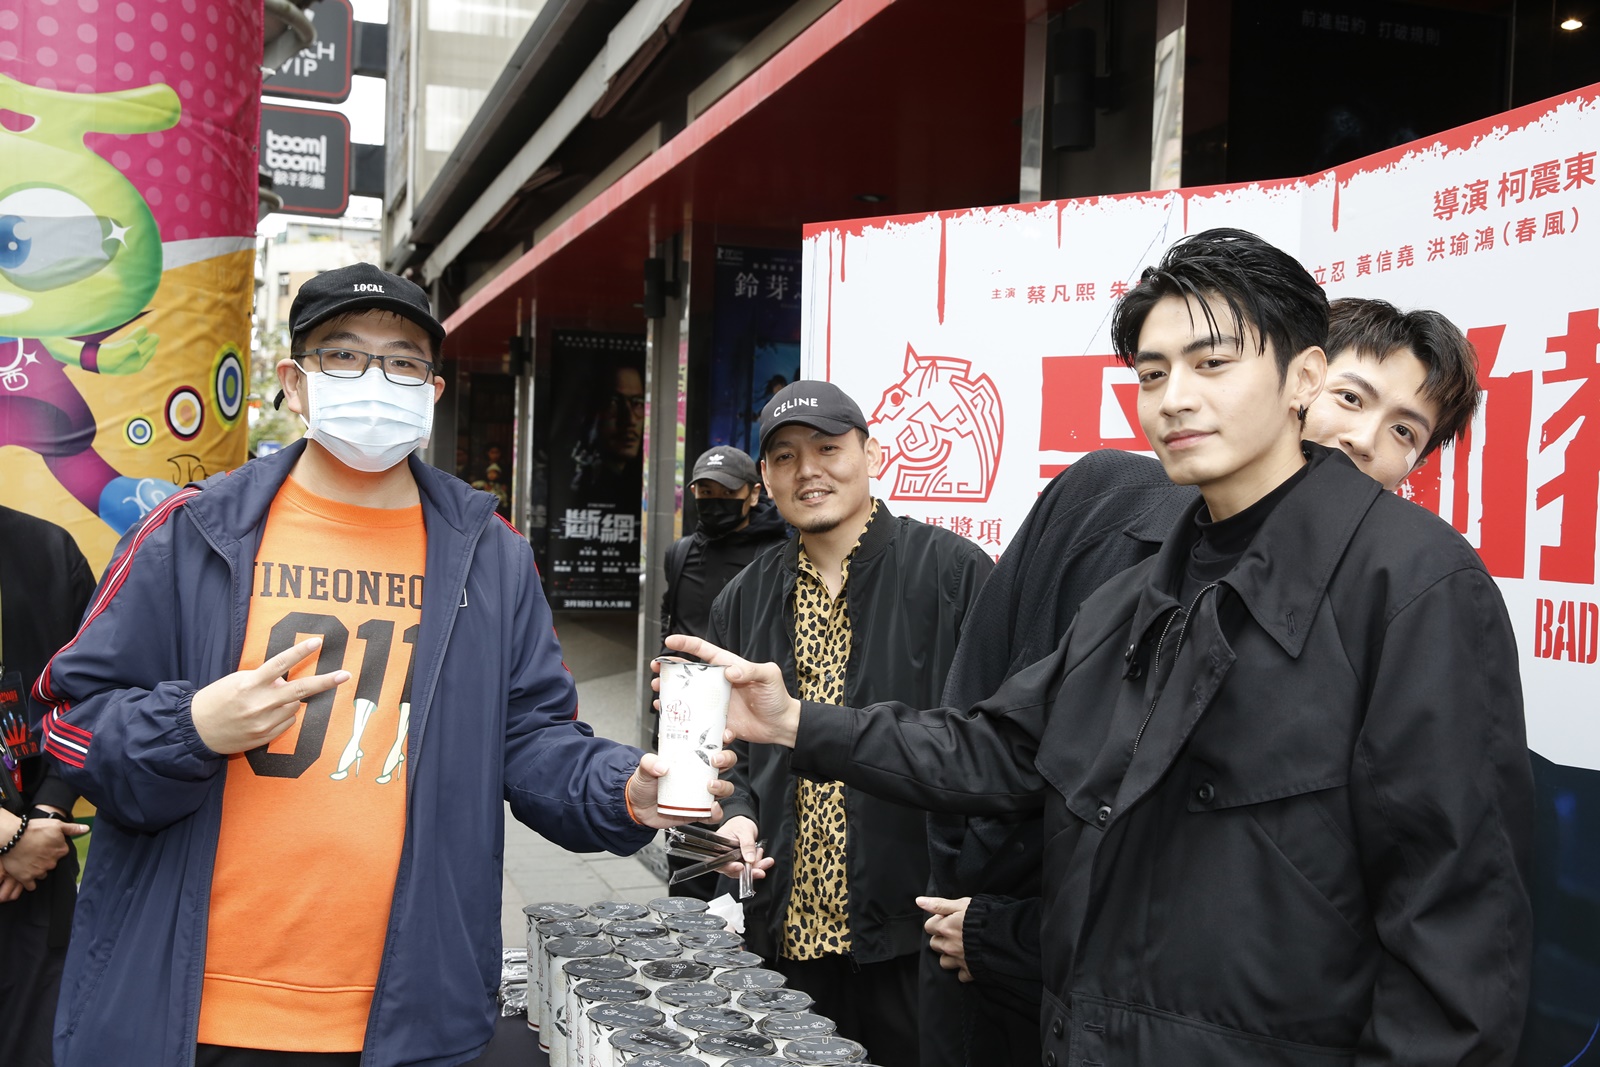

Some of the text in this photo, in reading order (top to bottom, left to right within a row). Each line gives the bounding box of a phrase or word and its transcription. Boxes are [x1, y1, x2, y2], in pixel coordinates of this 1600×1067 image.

[1301, 9, 1441, 46] 前進紐約 打破規則
[282, 58, 318, 77] VIP
[1433, 151, 1597, 221] 導演 柯震東
[353, 283, 385, 294] LOCAL
[735, 271, 802, 300] 鈴芽
[991, 287, 1016, 300] 主演
[1027, 283, 1096, 304] 蔡凡熙
[1110, 280, 1142, 299] 朱
[1305, 260, 1345, 286] 立忍
[1356, 245, 1414, 278] 黃信堯
[773, 397, 819, 417] CELINE
[565, 508, 635, 543] 斷網
[251, 561, 425, 610] INEONEO
[1534, 598, 1599, 664] BAD
